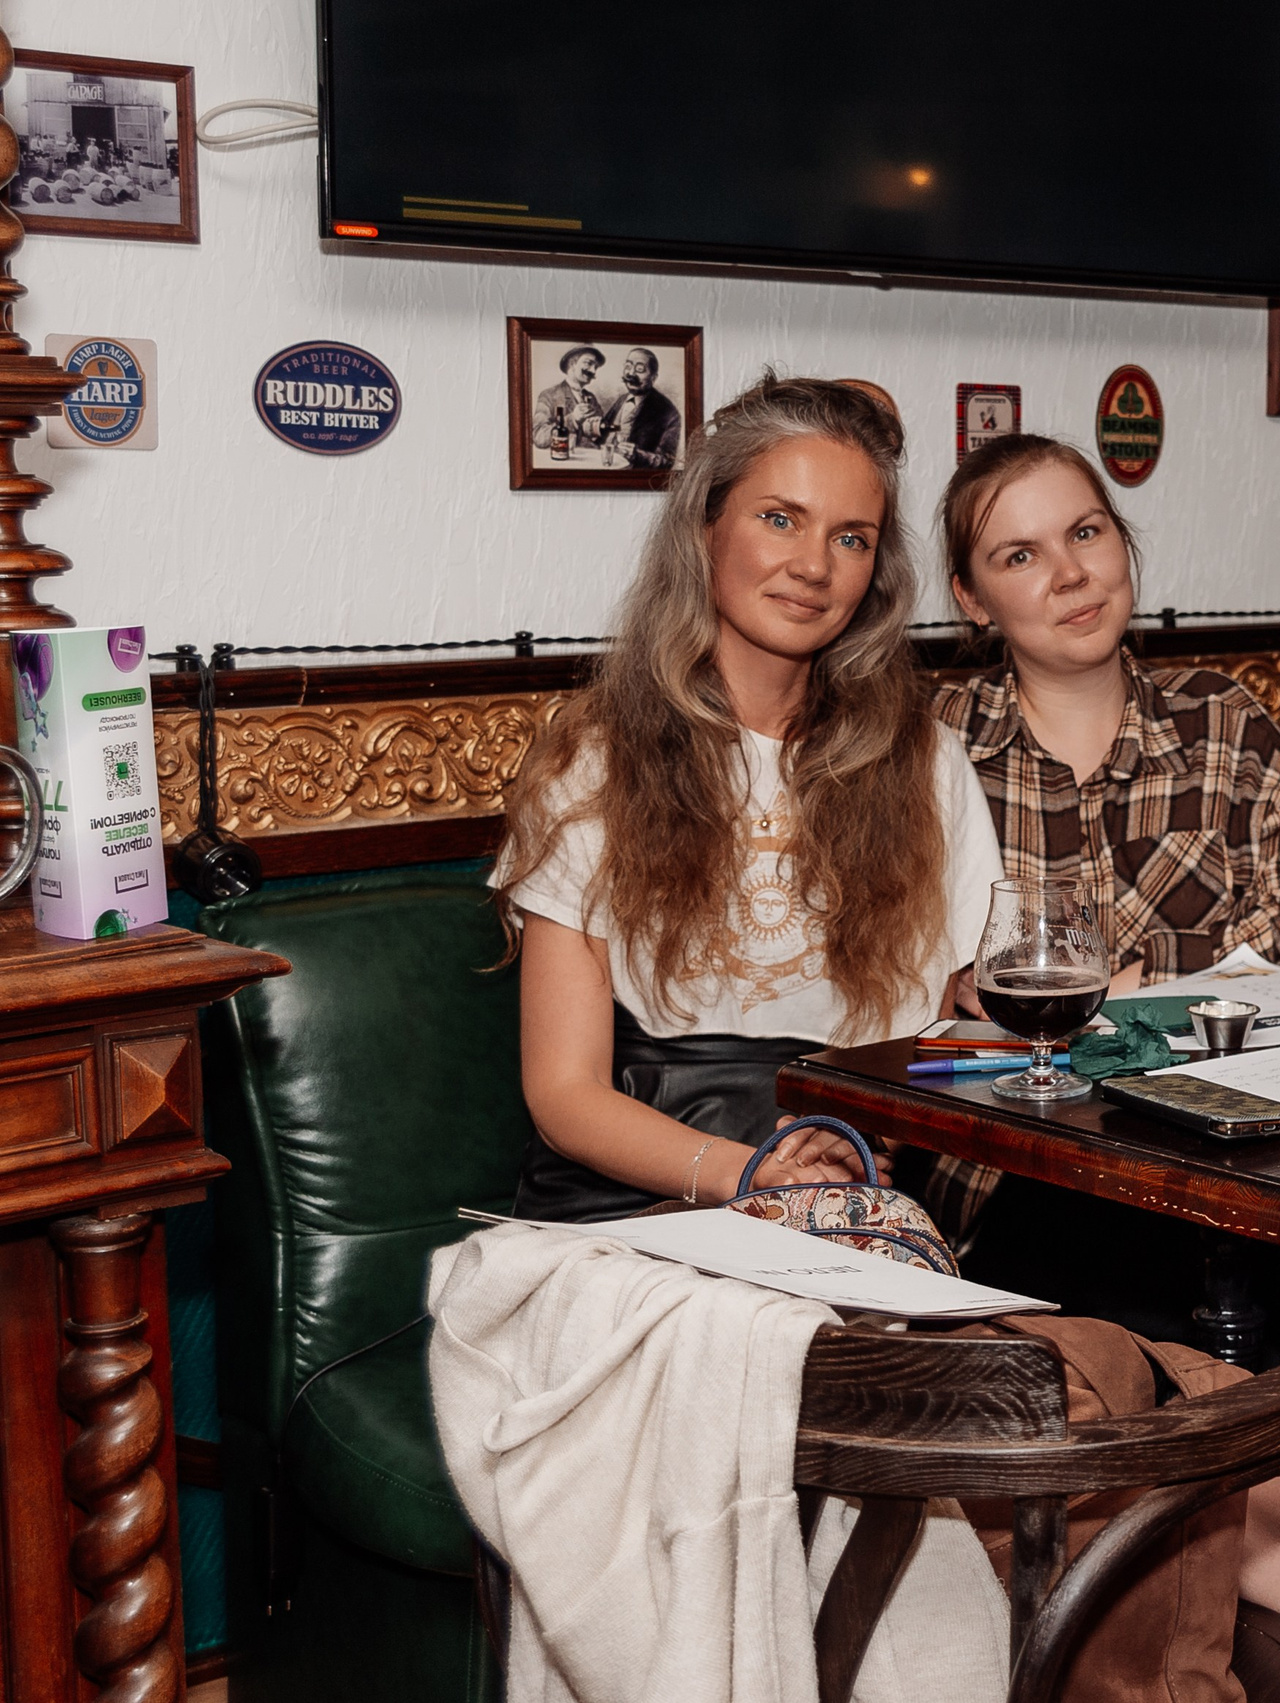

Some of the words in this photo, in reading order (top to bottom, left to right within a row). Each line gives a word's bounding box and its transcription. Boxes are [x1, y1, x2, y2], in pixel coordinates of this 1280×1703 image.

[67, 85, 104, 101] GARAGE
[72, 344, 99, 367] HARP
[101, 343, 134, 370] LAGER
[282, 352, 376, 379] TRADITIONAL
[313, 364, 349, 375] BEER
[70, 381, 139, 404] HARP
[265, 379, 395, 412] RUDDLES
[89, 408, 121, 423] lager
[279, 410, 321, 426] BEST
[323, 412, 380, 430] BITTER
[1109, 443, 1150, 457] STOUT
[88, 691, 142, 707] BEERHOUSE1
[90, 808, 150, 830] ФРИБЕТОМ!
[104, 822, 149, 842] ВЕСЕЛЕЕ
[101, 836, 153, 857] ОТДЫХАТЬ
